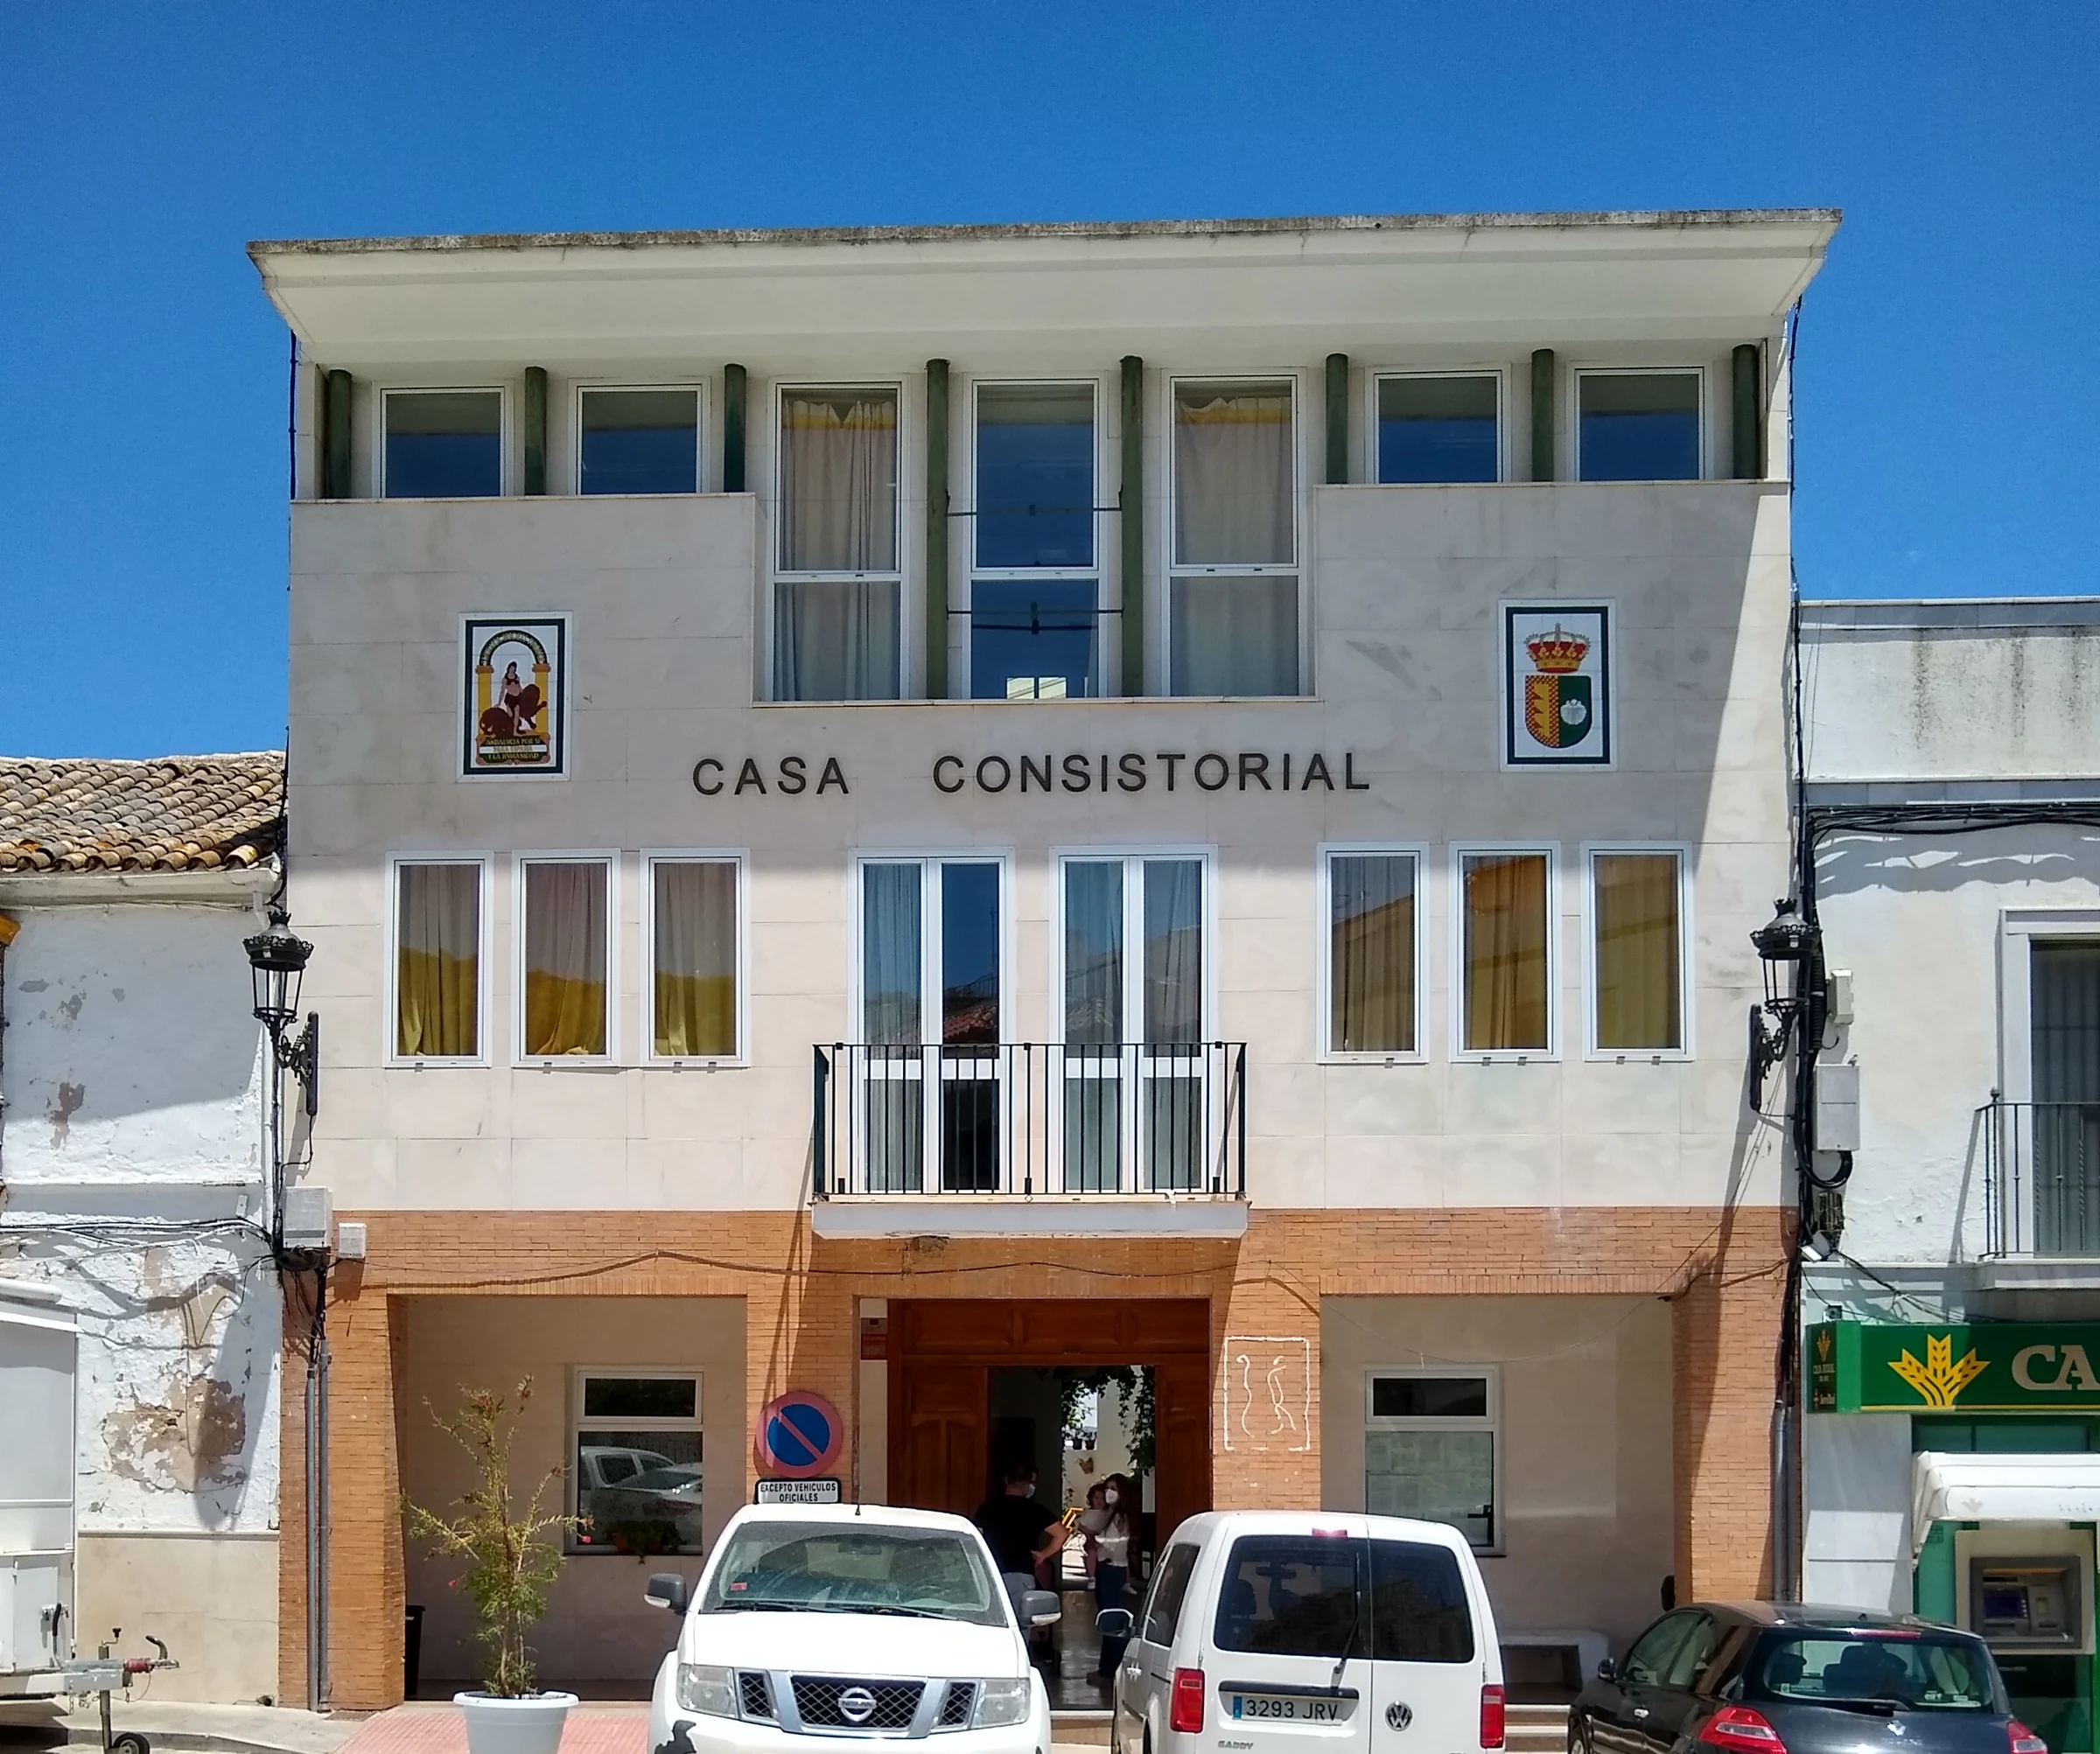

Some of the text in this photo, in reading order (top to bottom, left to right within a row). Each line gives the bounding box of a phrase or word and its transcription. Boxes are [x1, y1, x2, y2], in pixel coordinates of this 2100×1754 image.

[692, 751, 1370, 795] CASA CONSISTORIAL
[2011, 1345, 2100, 1390] CA
[760, 1483, 836, 1492] EXCEPTO VEHICULOS
[779, 1493, 818, 1502] OFICIALES
[1246, 1700, 1338, 1721] 3293 JRV
